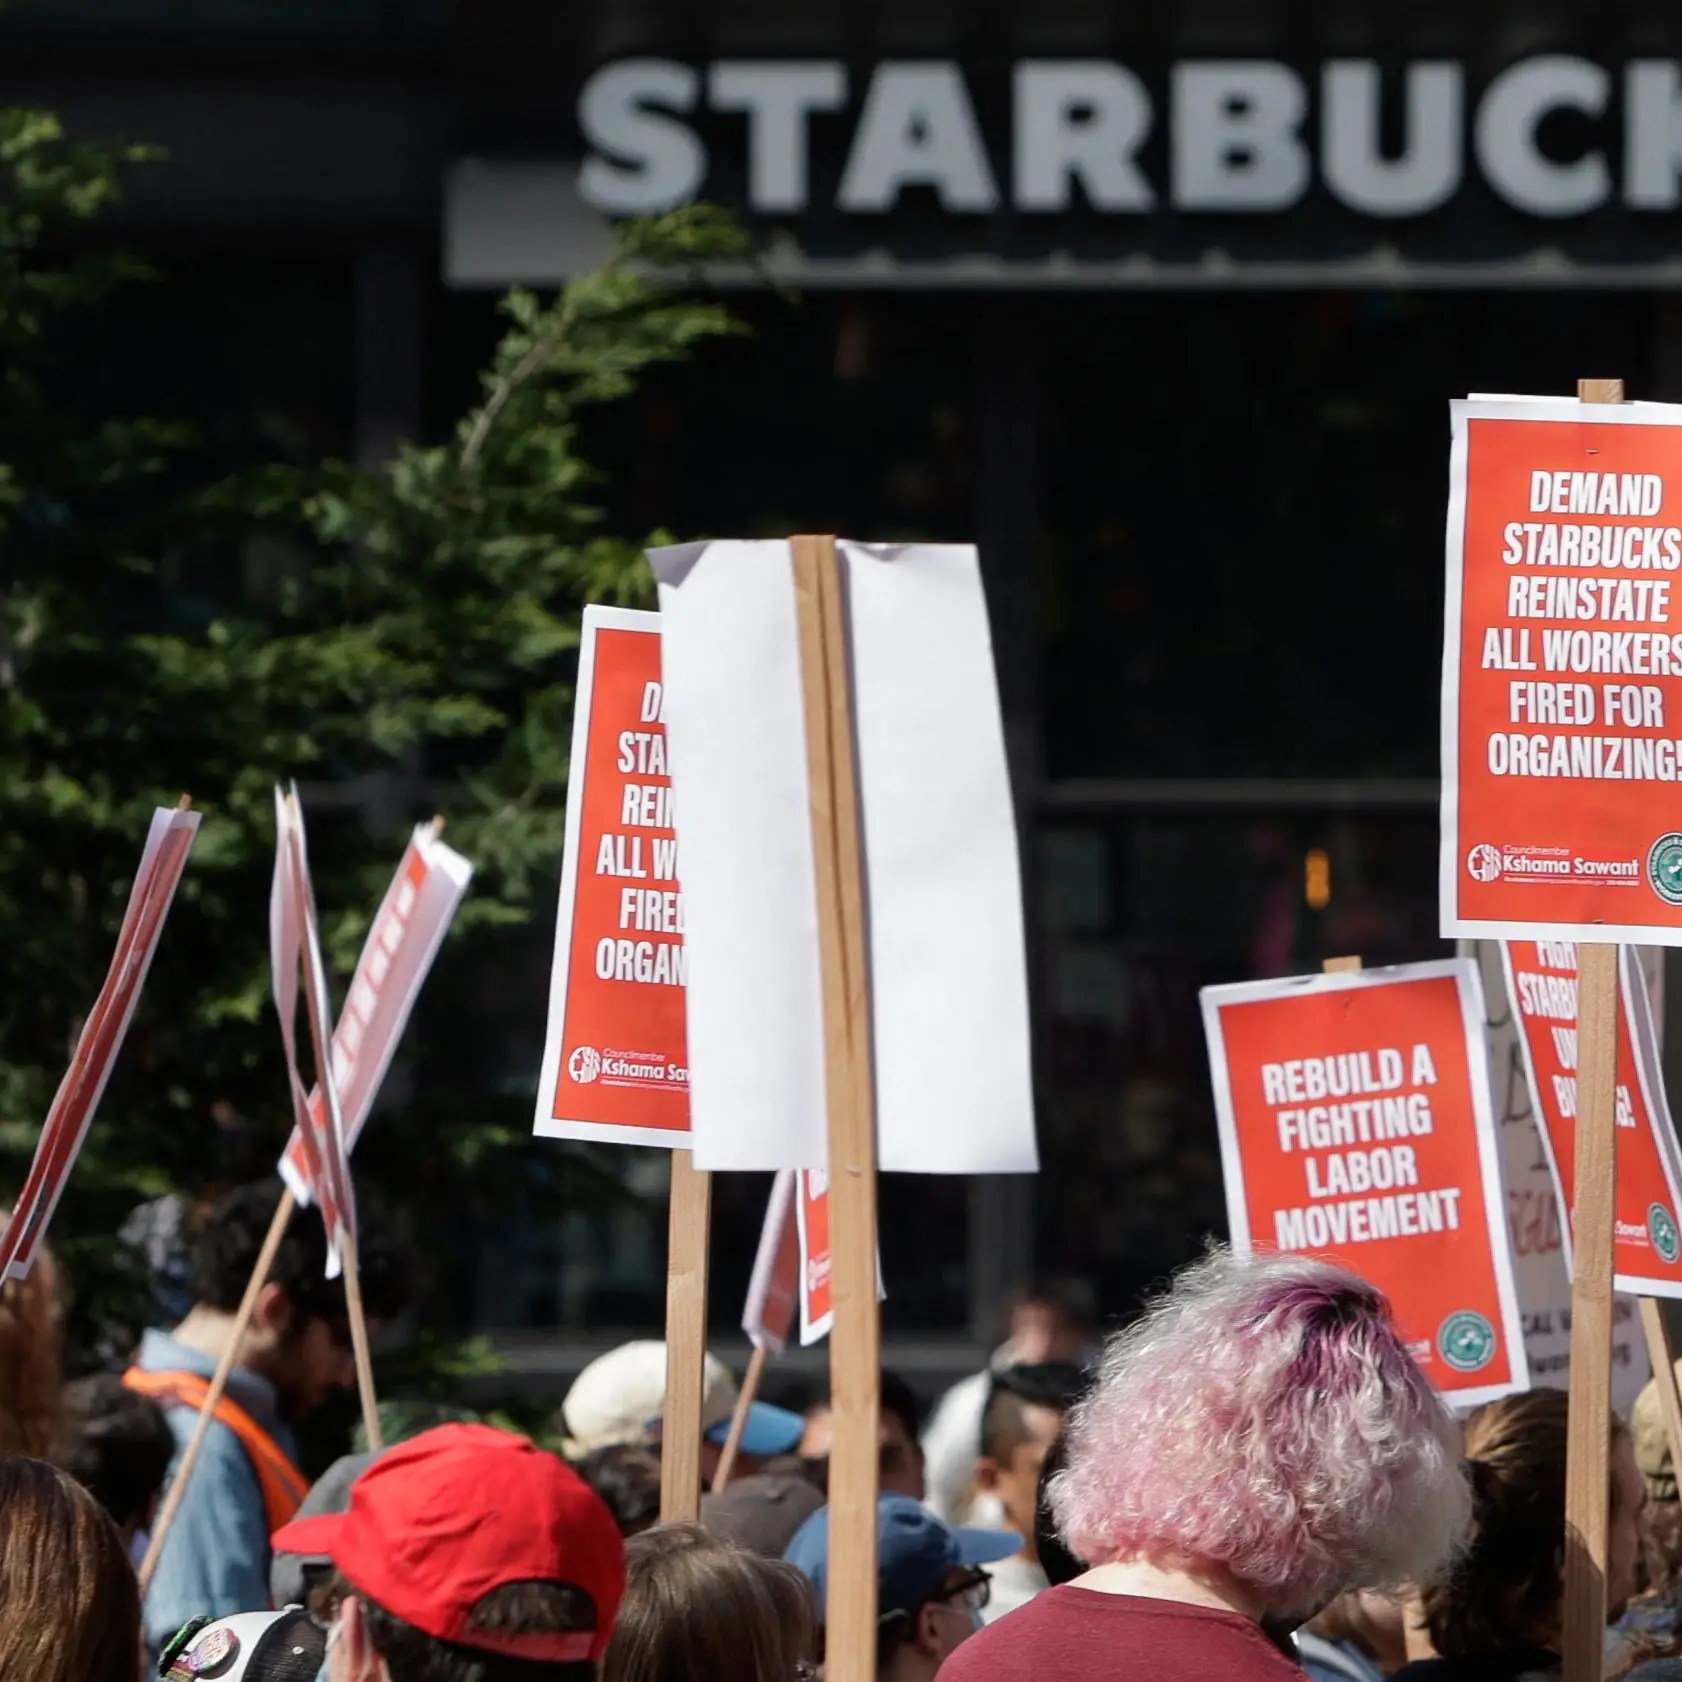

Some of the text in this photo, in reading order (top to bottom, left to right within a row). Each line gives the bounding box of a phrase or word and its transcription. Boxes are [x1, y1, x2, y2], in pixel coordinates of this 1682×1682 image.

[1529, 469, 1663, 516] DEMAND
[1502, 522, 1682, 570] STARBUCKS
[1507, 575, 1671, 623] REINSTATE
[1481, 627, 1537, 671] ALL
[1509, 681, 1665, 728] FIRED FOR
[596, 834, 647, 878] ALL
[1503, 855, 1639, 876] Kshama Sawant
[601, 1057, 665, 1080] Kshama
[1261, 1043, 1437, 1106] REBUILD A
[1276, 1093, 1433, 1153] FIGHTING
[1304, 1145, 1419, 1198] LABOR
[1273, 1187, 1461, 1252] MOVEMENT
